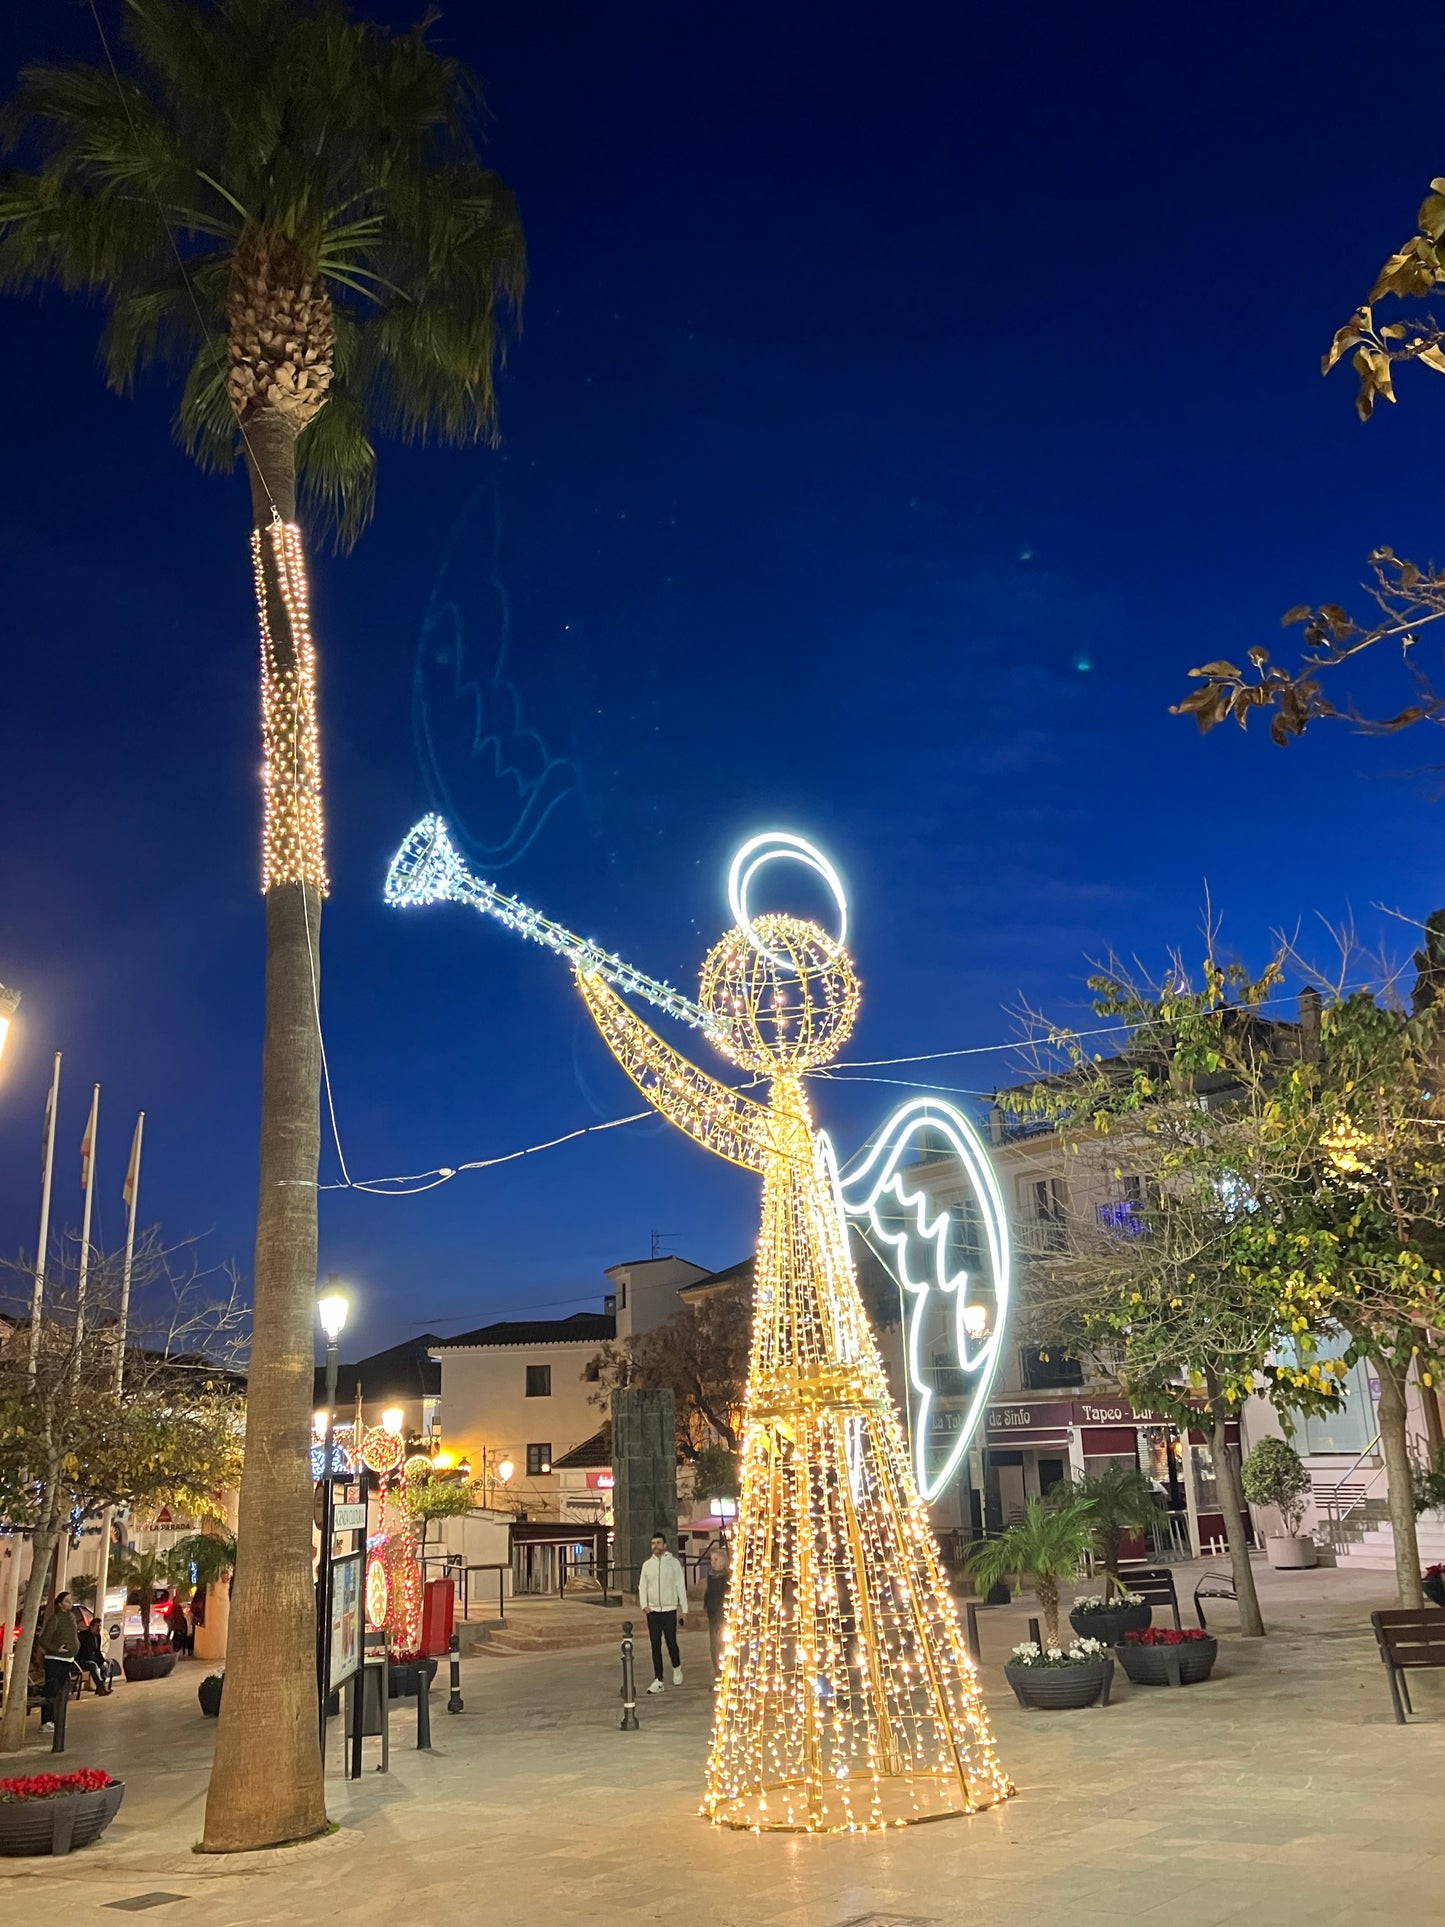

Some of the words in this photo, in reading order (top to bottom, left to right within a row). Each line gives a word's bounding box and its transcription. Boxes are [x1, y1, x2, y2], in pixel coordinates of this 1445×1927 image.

[932, 1414, 944, 1430] La
[989, 1411, 1002, 1427] de
[1082, 1405, 1122, 1423] Tapeo
[160, 1523, 191, 1531] PARADA
